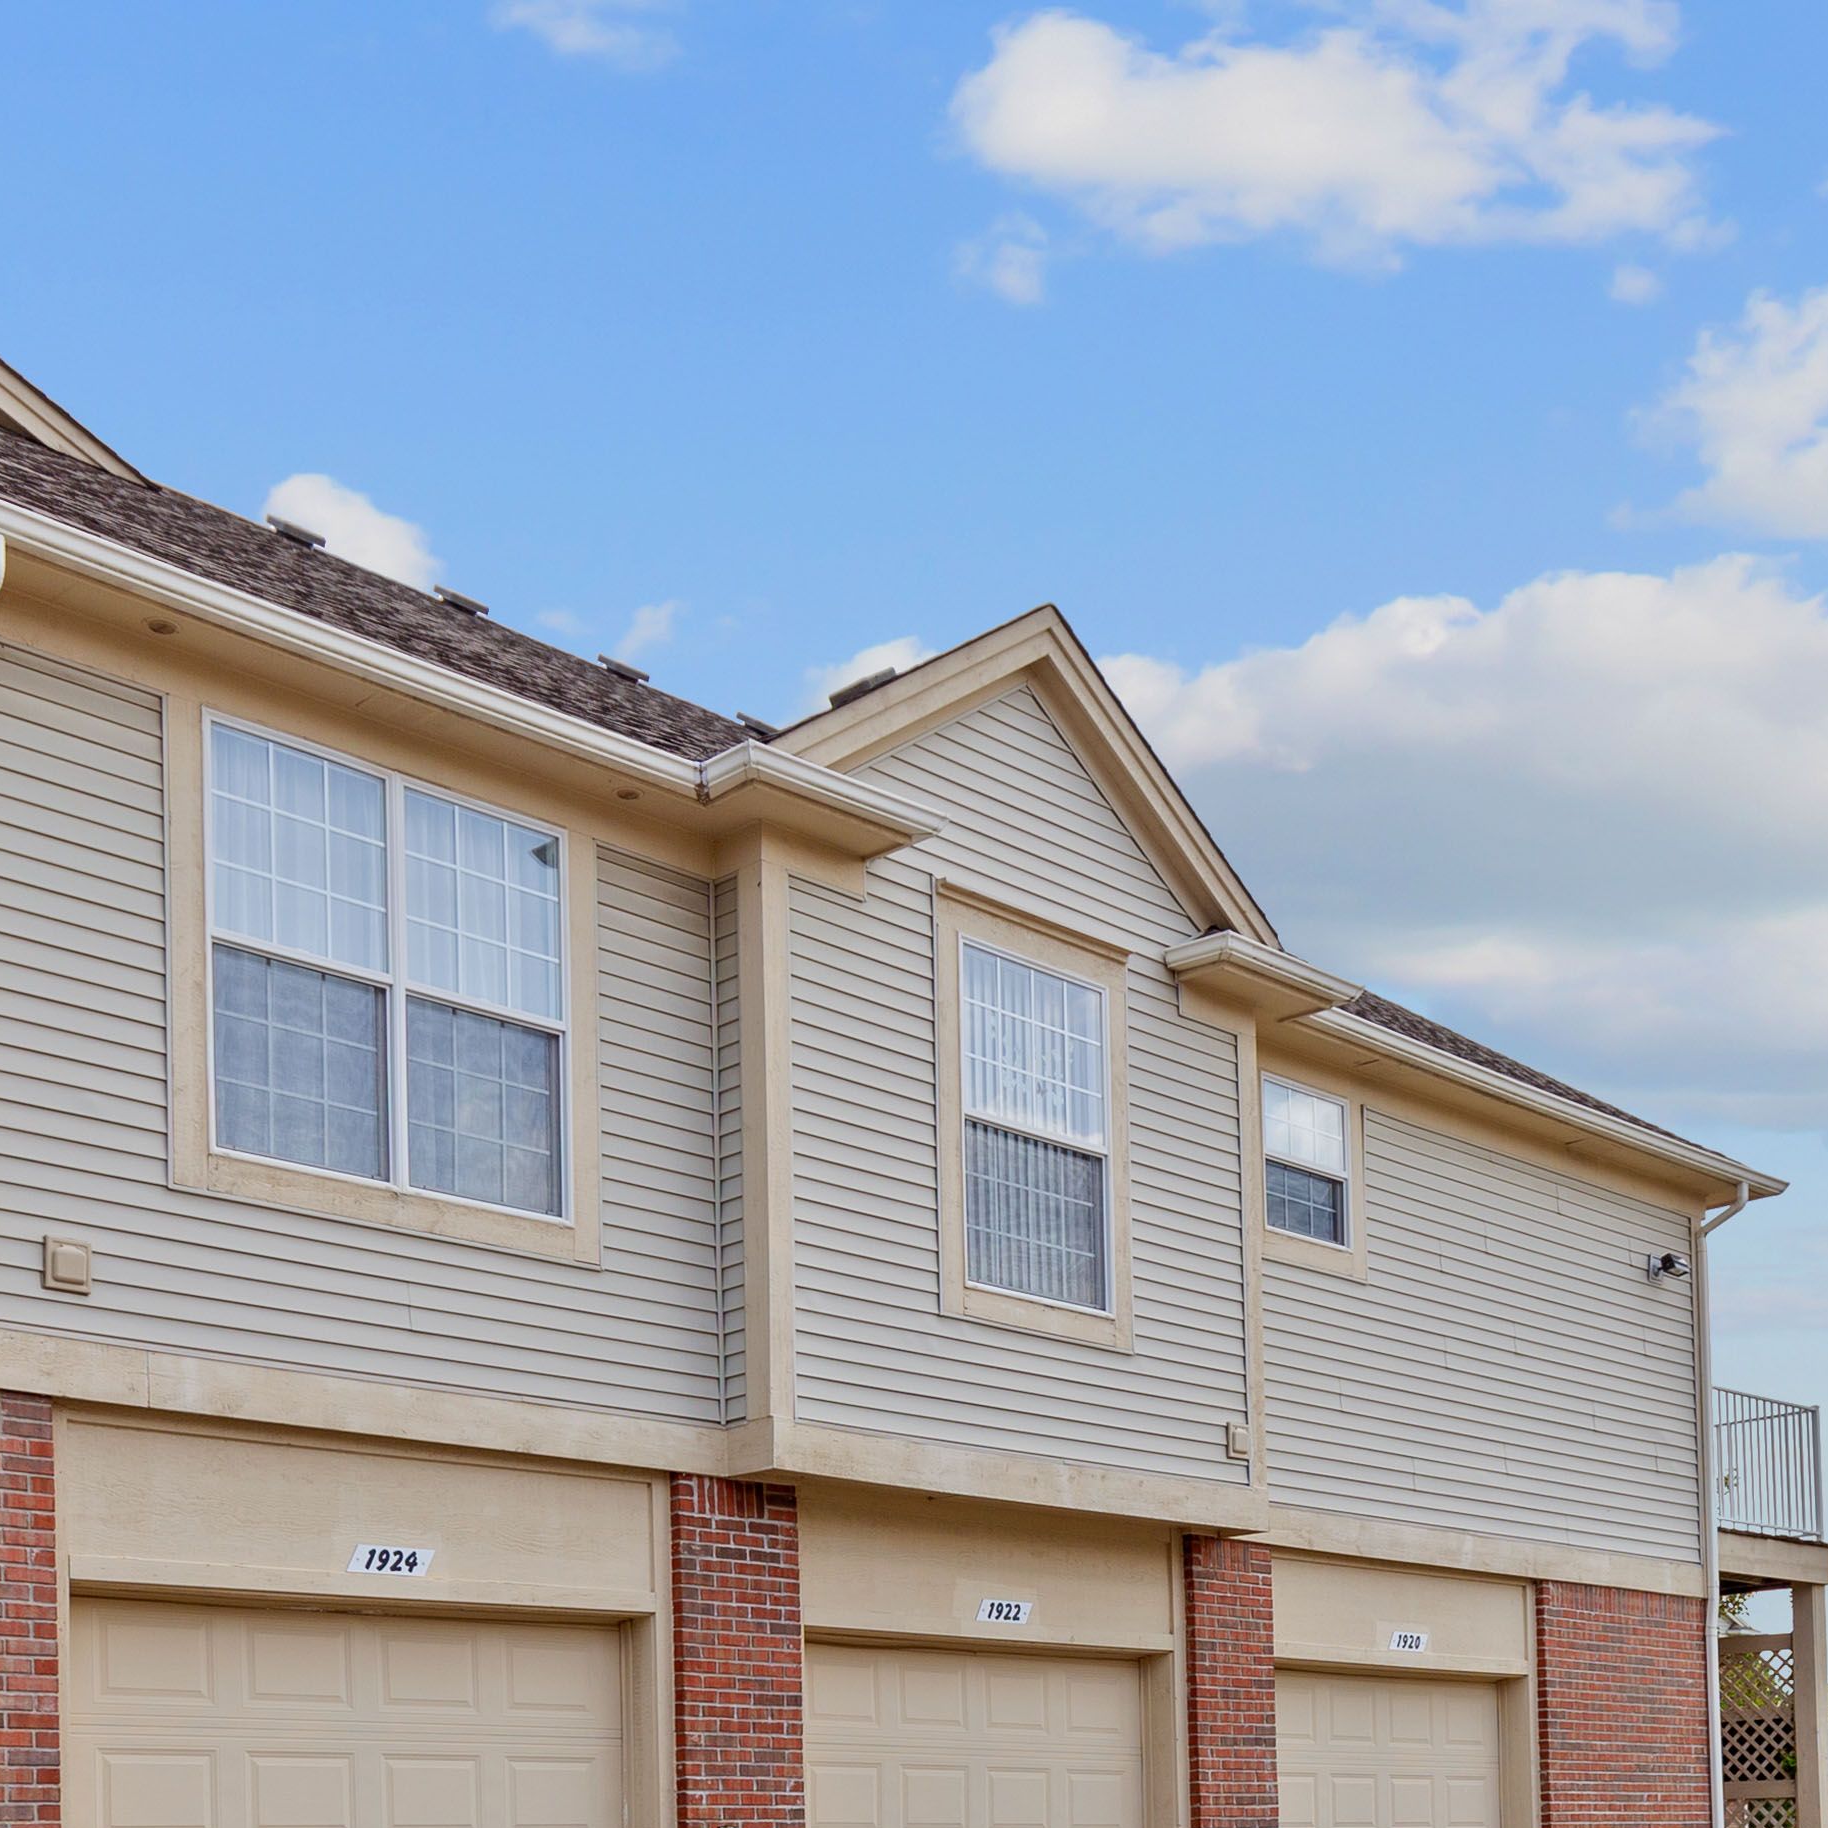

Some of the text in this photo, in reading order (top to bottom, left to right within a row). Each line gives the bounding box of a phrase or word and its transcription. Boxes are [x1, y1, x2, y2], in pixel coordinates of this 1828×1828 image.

[364, 1548, 418, 1573] 1924
[987, 1602, 1021, 1621] 1922
[1396, 1634, 1421, 1649] 1920
